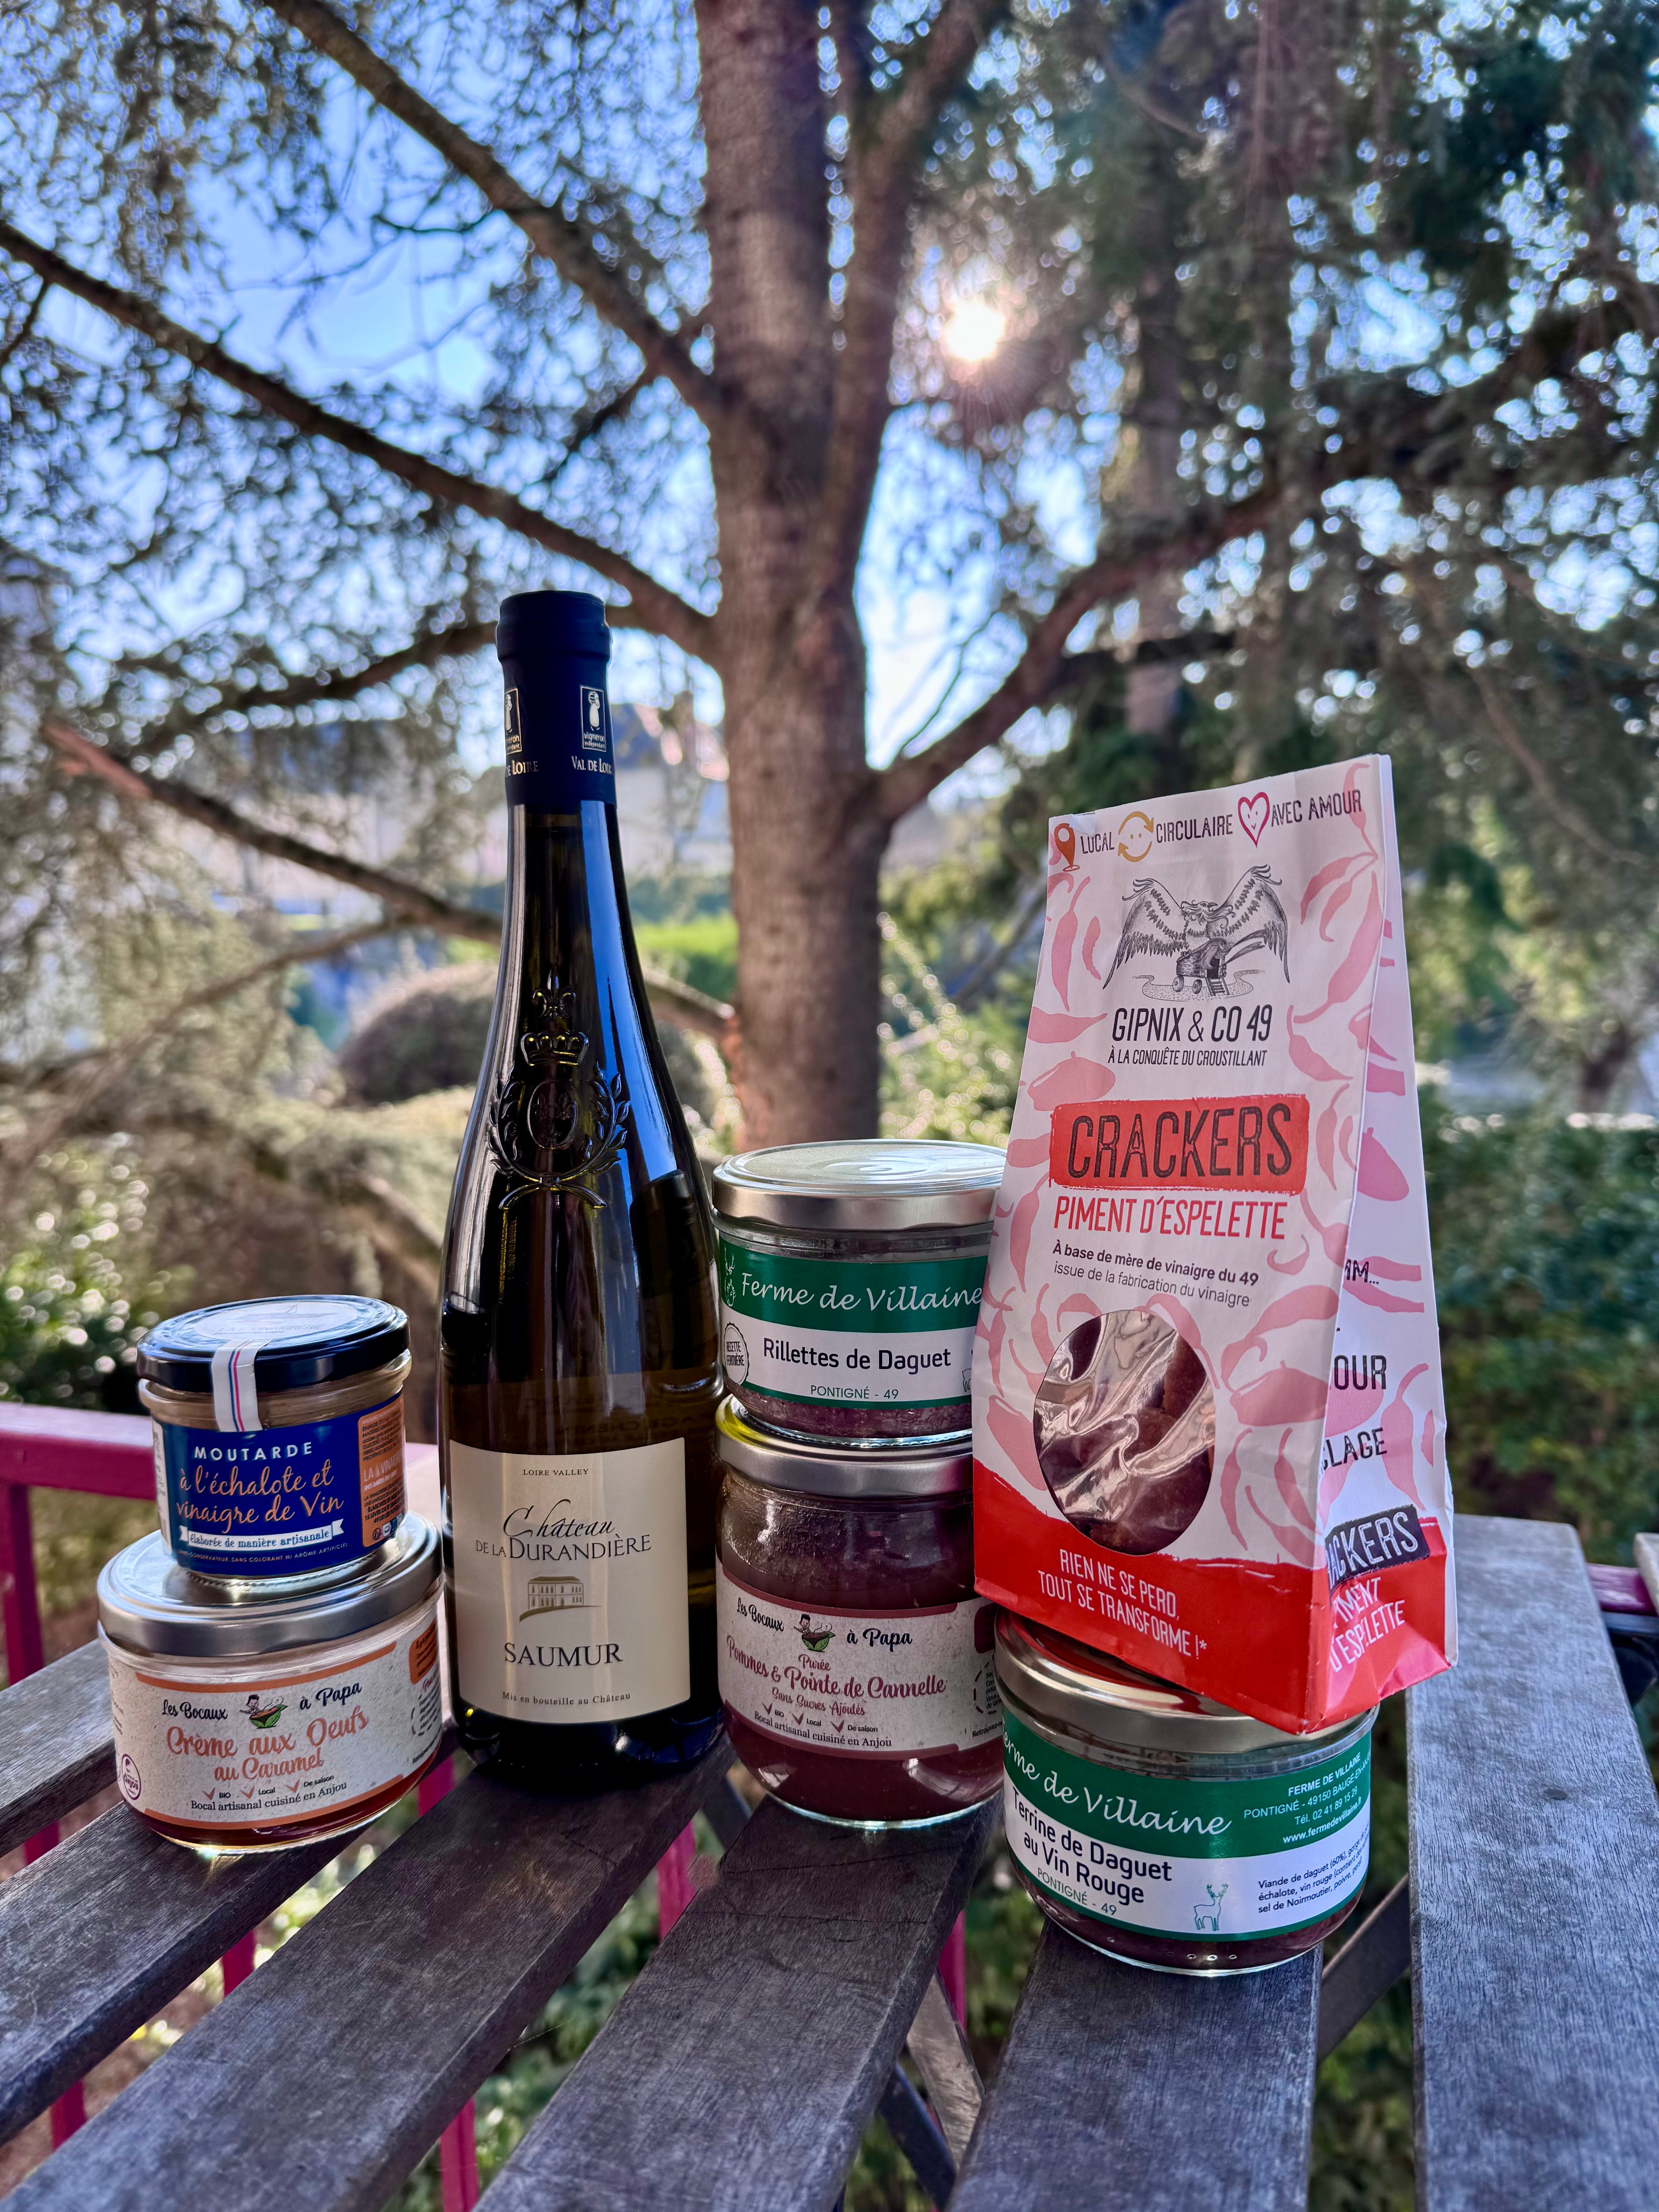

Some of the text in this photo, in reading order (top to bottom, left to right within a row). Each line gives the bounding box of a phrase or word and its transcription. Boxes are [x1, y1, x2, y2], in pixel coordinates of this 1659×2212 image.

[584, 732, 604, 743] vigneron
[1081, 789, 1361, 854] LOCAL CIRCULAIRE AVEC AMOUR
[1112, 1004, 1272, 1041] GIPNIX & CO 49
[1108, 1046, 1267, 1066] À LA CONQUÊTE DU CROUSTILLANT
[1068, 1103, 1291, 1179] CRACKERS
[1054, 1195, 1288, 1240] PIMENT D'ESPELETTE
[1052, 1240, 1259, 1287] À base de mère de vinaigre du 49
[742, 1273, 982, 1311] Ferme de Villaine
[1054, 1261, 1249, 1308] issue de la fabrication du vinaigre
[726, 1341, 741, 1352] RECETTE
[763, 1338, 951, 1374] Rillettes de Daguet
[811, 1385, 899, 1399] PONTIGNÉ 49
[194, 1442, 312, 1460] MOUTARDE
[180, 1468, 191, 1491] à
[195, 1465, 306, 1495] l'échalote
[312, 1459, 334, 1485] et
[176, 1500, 259, 1533] vinaigre
[264, 1494, 295, 1520] de
[300, 1491, 344, 1516] Vin
[503, 1499, 615, 1538] Château
[190, 1531, 329, 1548] élaborée de manière artisanale
[295, 1550, 316, 1558] ARÔME
[476, 1534, 652, 1560] DE LA DURANDIÈRE
[1060, 1548, 1179, 1620] RIEN NE SE PERD,
[737, 1597, 912, 1652] Les Bocaux à Papa
[1038, 1570, 1191, 1656] TOUT SE TRANSFORME
[505, 1643, 623, 1667] SAUMUR
[727, 1635, 946, 1698] Pommes & Pointe de Cannelle
[798, 1654, 831, 1671] Purée
[162, 1682, 362, 1720] Les Bocaux à Papa
[502, 1691, 517, 1701] Mis
[533, 1695, 574, 1705] bouteille
[592, 1692, 631, 1703] Château
[772, 1687, 866, 1716] Sans Sucres Ajoutés
[167, 1705, 369, 1758] Crème aux Oeufs
[754, 1710, 772, 1726] Bocal
[775, 1722, 810, 1738] artisanal
[813, 1733, 845, 1744] cuisiné
[862, 1738, 892, 1748] Anjou
[215, 1747, 324, 1781] au Caramel
[315, 1775, 334, 1785] saison
[1288, 1752, 1361, 1797] FERME DE VILLAINE
[191, 1801, 216, 1810] Bocal
[219, 1800, 261, 1811] artisanal
[265, 1793, 301, 1808] cuisiné
[318, 1782, 346, 1797] Anjou
[1044, 1770, 1232, 1834] de Villaine
[1244, 1790, 1331, 1818] PONTIGNÉ 49150
[1295, 1786, 1357, 1825] Tél. 02 41 89 15 29
[1013, 1786, 1172, 1881] Terrine de Daguet
[1283, 1796, 1362, 1843] www.fermedevillaine.fr
[1024, 1832, 1144, 1906] au Vin Rouge
[1259, 1863, 1329, 1888] Viande de daguet
[1259, 1888, 1298, 1901] échalote,
[1313, 1873, 1333, 1888] rouge
[1038, 1867, 1116, 1915] PONTIGNÉ 49
[1259, 1872, 1352, 1913] sel de Noirmoutier, poivre,
